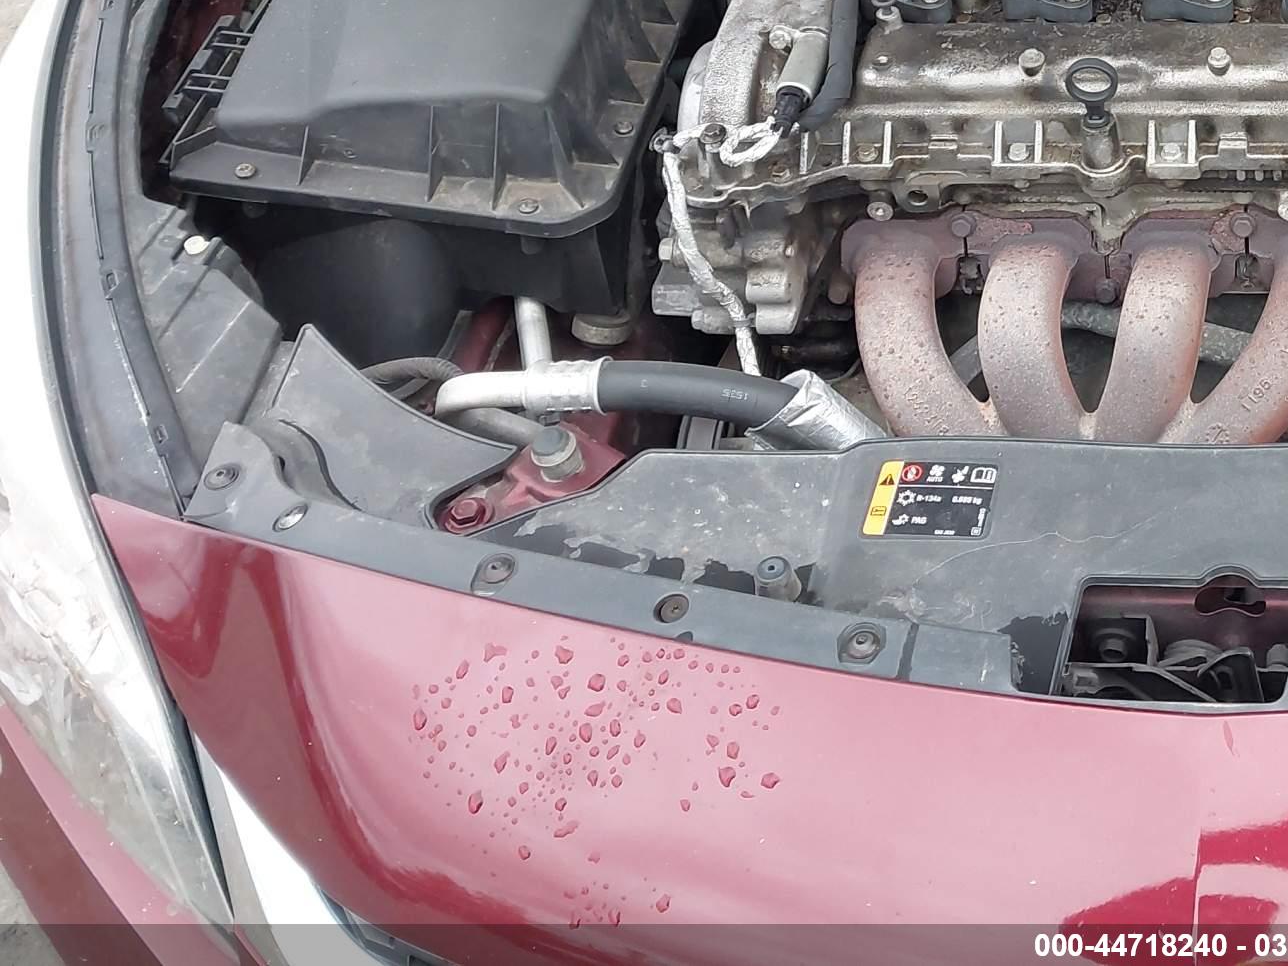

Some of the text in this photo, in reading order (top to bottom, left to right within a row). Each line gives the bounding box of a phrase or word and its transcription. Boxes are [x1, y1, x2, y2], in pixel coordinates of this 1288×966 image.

[926, 475, 944, 483] AUTO
[916, 494, 943, 503] R-134a
[911, 516, 928, 525] PAG
